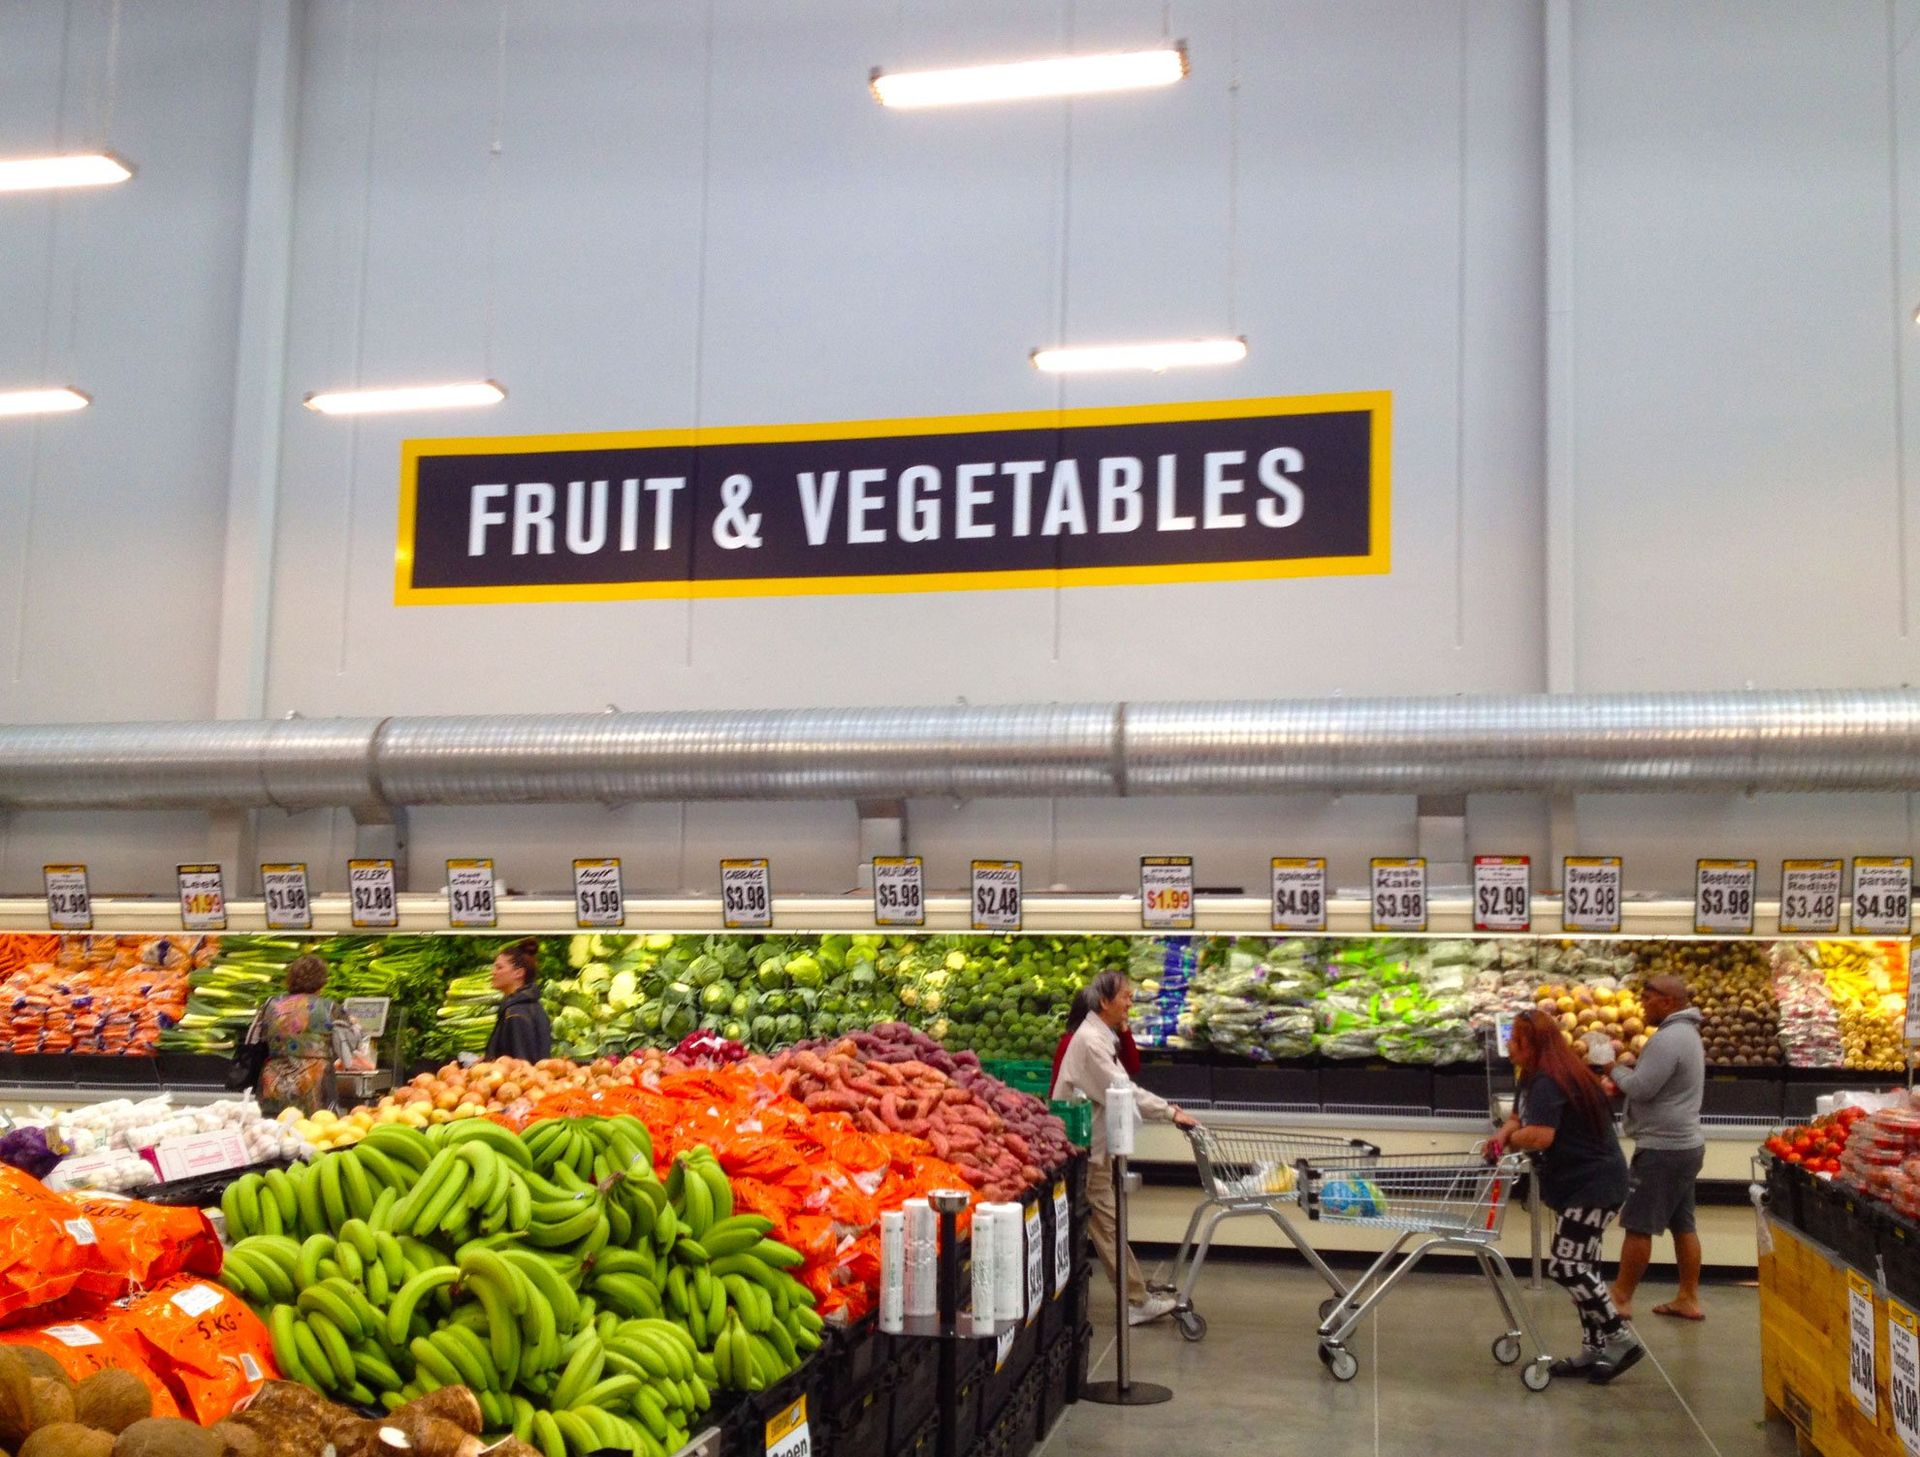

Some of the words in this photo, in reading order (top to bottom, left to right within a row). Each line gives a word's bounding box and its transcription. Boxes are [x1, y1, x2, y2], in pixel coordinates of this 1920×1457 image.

[467, 476, 687, 557] FRUIT
[711, 473, 764, 550] &
[796, 446, 1306, 547] VEGETABLES
[353, 869, 391, 881] CELERY
[580, 868, 613, 878] half
[724, 869, 765, 881] CABBAGE
[877, 866, 919, 878] CAULIFLOWER
[975, 870, 1018, 881] BROCCOLI
[1376, 878, 1422, 888] Kale
[1377, 868, 1419, 878] Fresh
[1569, 868, 1617, 883] Swedes
[1701, 870, 1751, 885] Beetroot
[1858, 877, 1908, 889] parsnip
[51, 893, 87, 913] $2.98
[185, 893, 221, 913] $1.99
[268, 888, 306, 911] $1.98
[355, 886, 392, 910] $2.88
[454, 889, 491, 913] $1.48
[581, 889, 619, 913] $1.99
[726, 885, 766, 912] $3.98
[879, 882, 920, 909] $5.98
[977, 884, 1018, 917] $2.48
[1147, 889, 1190, 911] $1.99
[1277, 889, 1321, 916] $4.98
[1376, 893, 1422, 918] $3.98
[1479, 885, 1526, 916] $2.99
[1568, 886, 1616, 916] $2.98
[1702, 887, 1750, 916] $3.98
[1786, 895, 1834, 918] $3.48
[1856, 893, 1907, 919] $4.98
[197, 1320, 211, 1340] 5
[212, 1313, 238, 1334] KG
[1851, 1340, 1873, 1394] $3.98
[1892, 1373, 1919, 1437] $3.98
